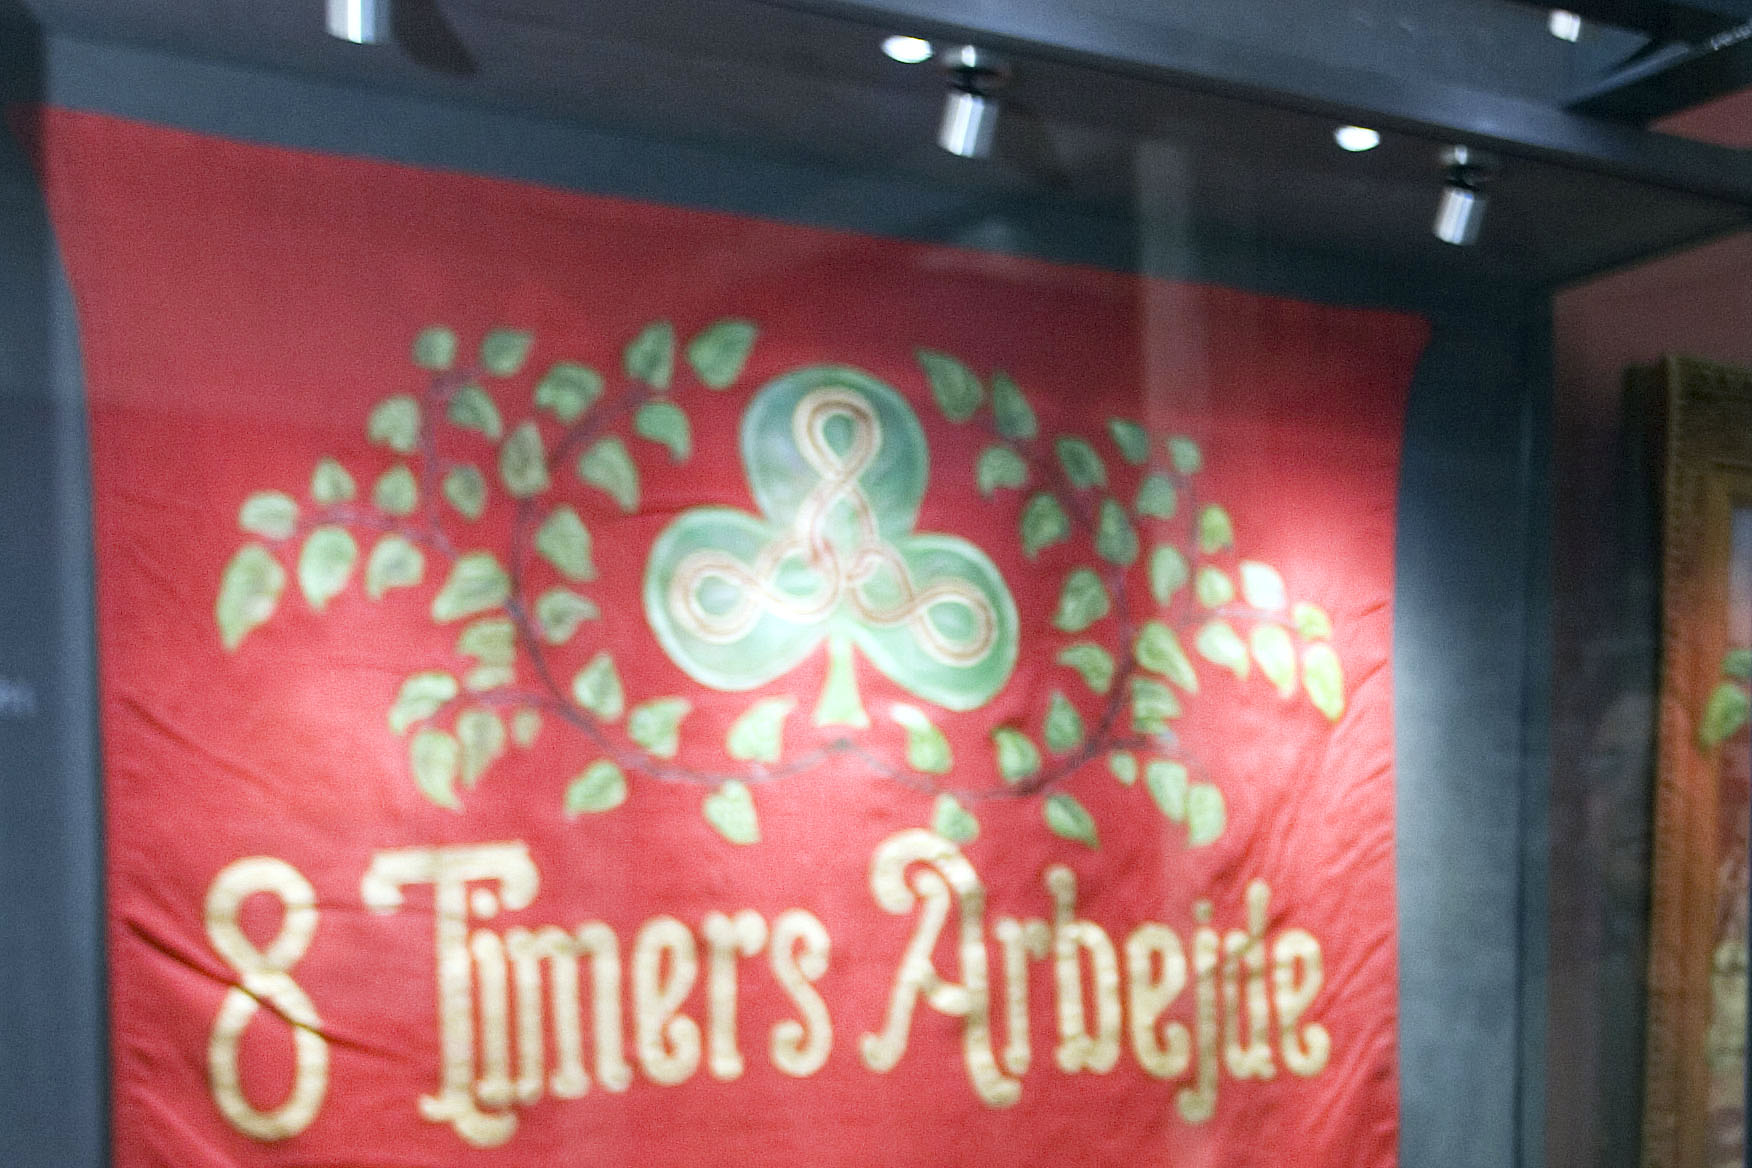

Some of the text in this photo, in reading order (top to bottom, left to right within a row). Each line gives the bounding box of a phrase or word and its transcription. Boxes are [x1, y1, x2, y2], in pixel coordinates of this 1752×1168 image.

[205, 827, 1331, 1147] 8 Timers Arbejde
